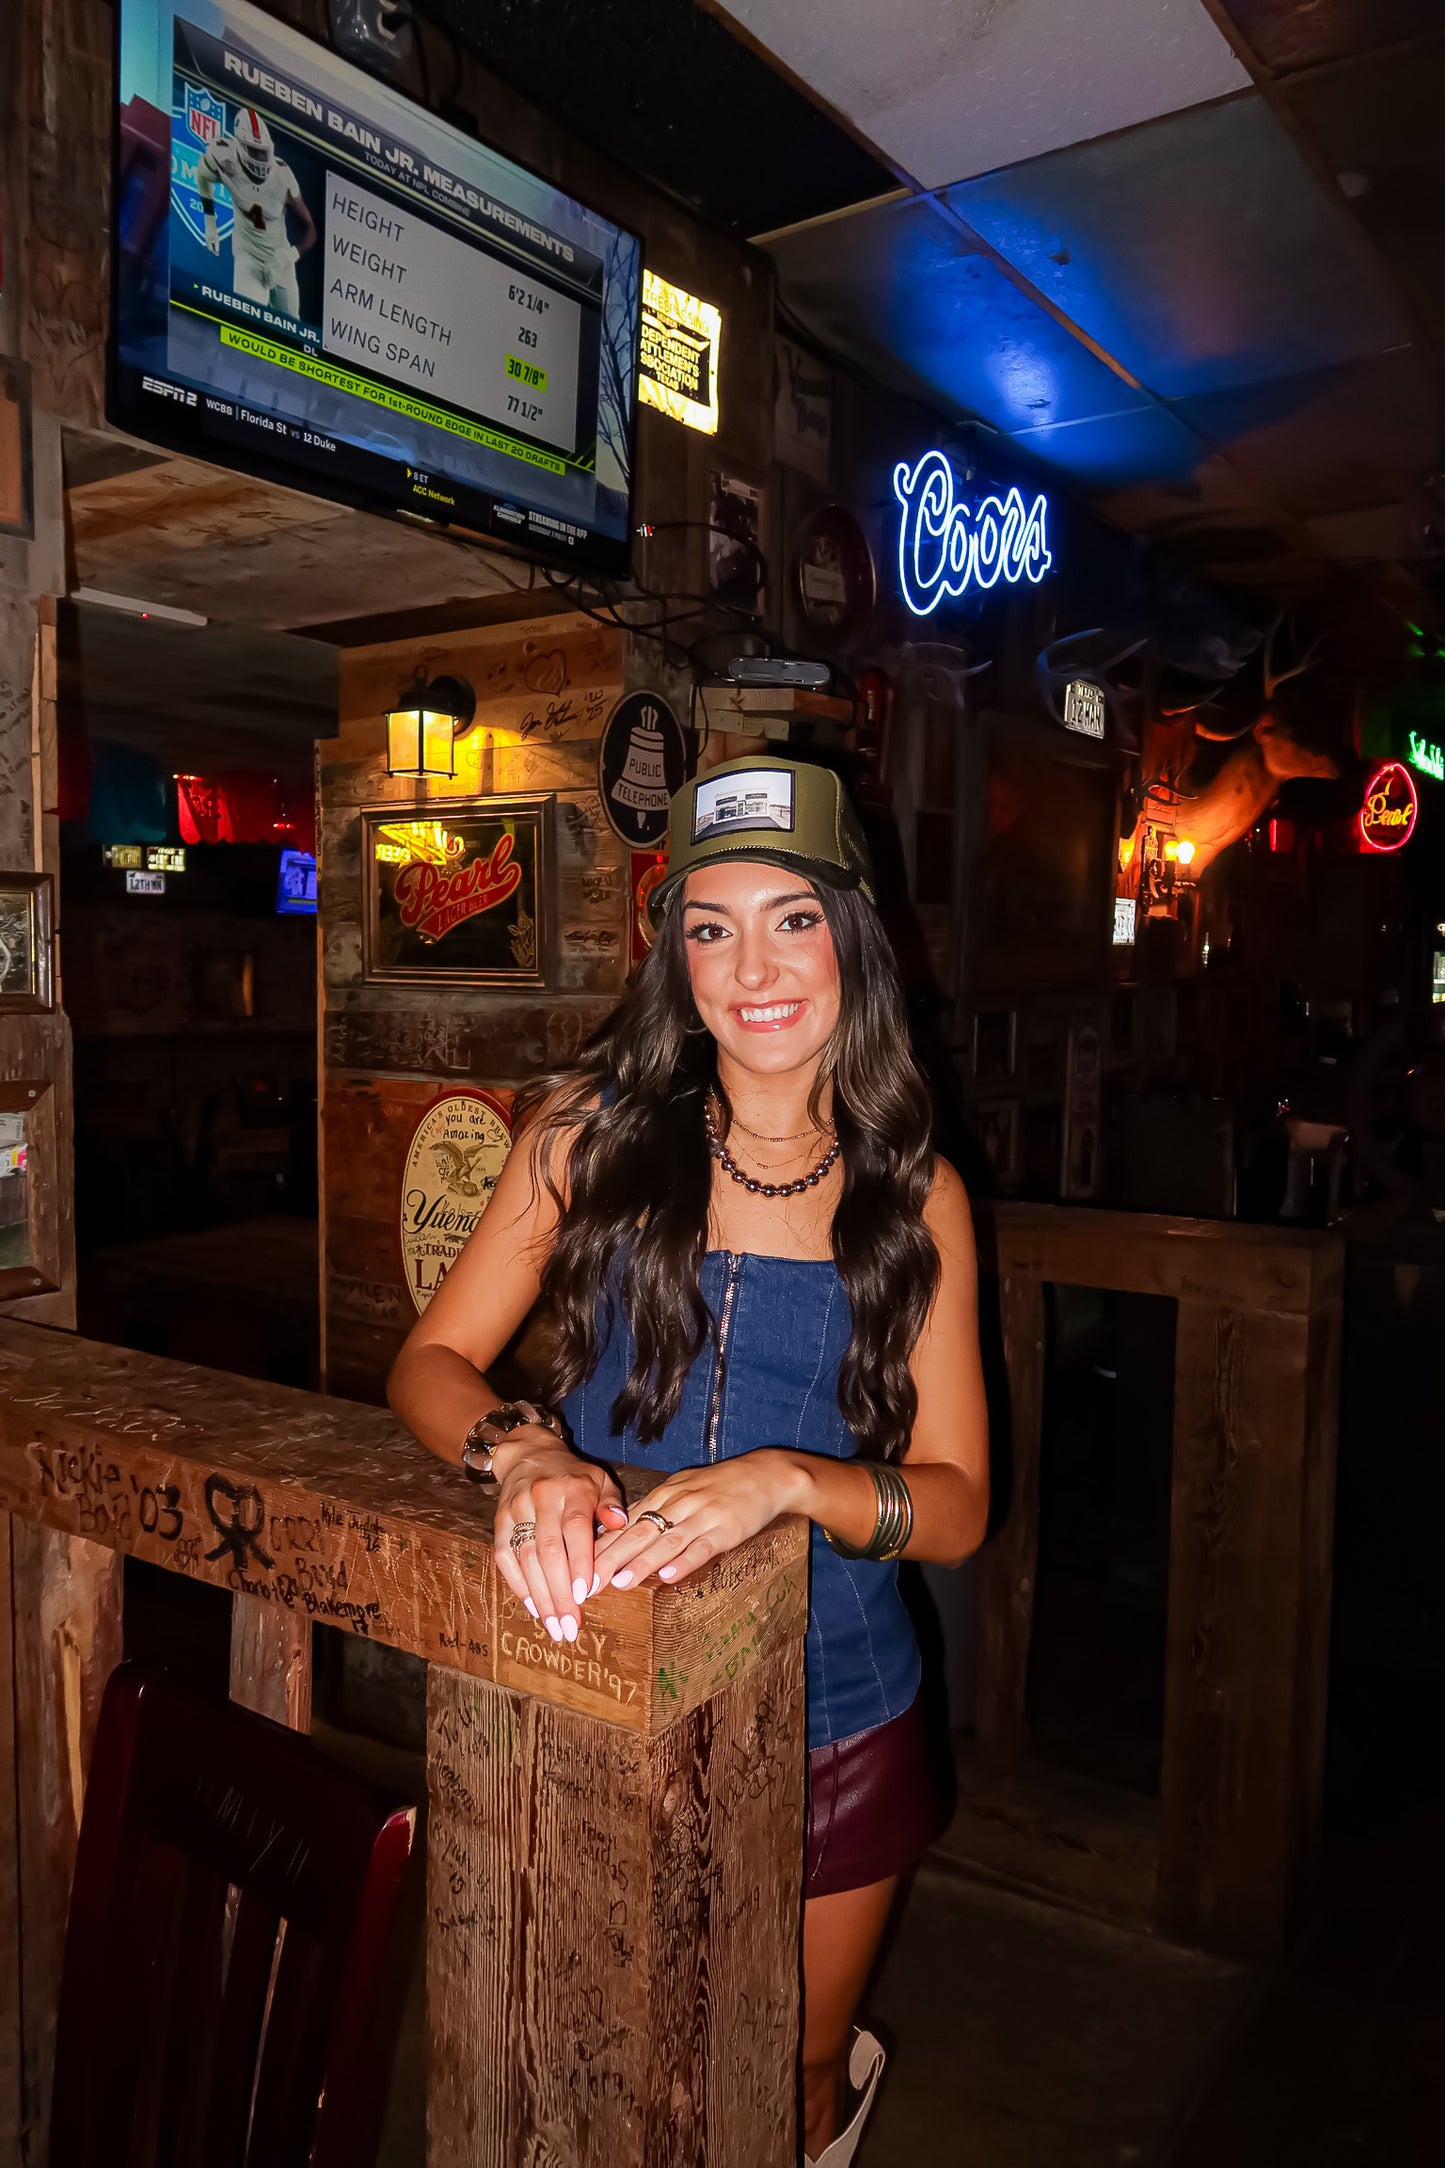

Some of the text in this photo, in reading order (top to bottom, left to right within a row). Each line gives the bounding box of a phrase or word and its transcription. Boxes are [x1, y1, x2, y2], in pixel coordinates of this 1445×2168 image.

[224, 51, 574, 263] RUEBEN BAIN JR. MEASUREMENTS
[365, 152, 470, 218] TODAY AT NFL COMBINE
[332, 192, 405, 242] HEIGHT
[332, 234, 407, 284] WEIGHT
[202, 285, 321, 344] RUEBEN BAIN JR.
[330, 278, 452, 346] ARM LENGTH
[508, 284, 525, 304] 6'2
[303, 344, 318, 358] DL
[331, 317, 436, 378] WING SPAN
[518, 327, 538, 349] 263
[640, 337, 699, 378] ATTLEMEN'S
[641, 323, 701, 362] DEPENDENT
[508, 359, 546, 386] 30 7/8"
[640, 351, 699, 392] SSOCIATION
[655, 369, 680, 392] TEXAS
[229, 333, 561, 472] WOULD BE SHORTEST FOR 1st-ROUND EDGE IN LAST 20 DRAFTS
[507, 395, 544, 422] 77 1/2"
[205, 398, 233, 416] WCBB
[241, 409, 274, 431] Florida
[276, 421, 287, 436] St
[303, 432, 312, 444] 12
[313, 436, 336, 452] Duke
[413, 471, 429, 484] 8 ET
[413, 484, 427, 496] ACC
[893, 450, 1052, 616] Coors
[629, 757, 662, 778] PUBLIC
[617, 782, 668, 807] TELEPHONE
[394, 832, 522, 927] Pearl
[438, 894, 488, 931] LAGER BEER
[412, 1110, 443, 1168] AMERICA'S
[447, 1102, 486, 1118] OLDEST
[445, 1113, 486, 1126] you are
